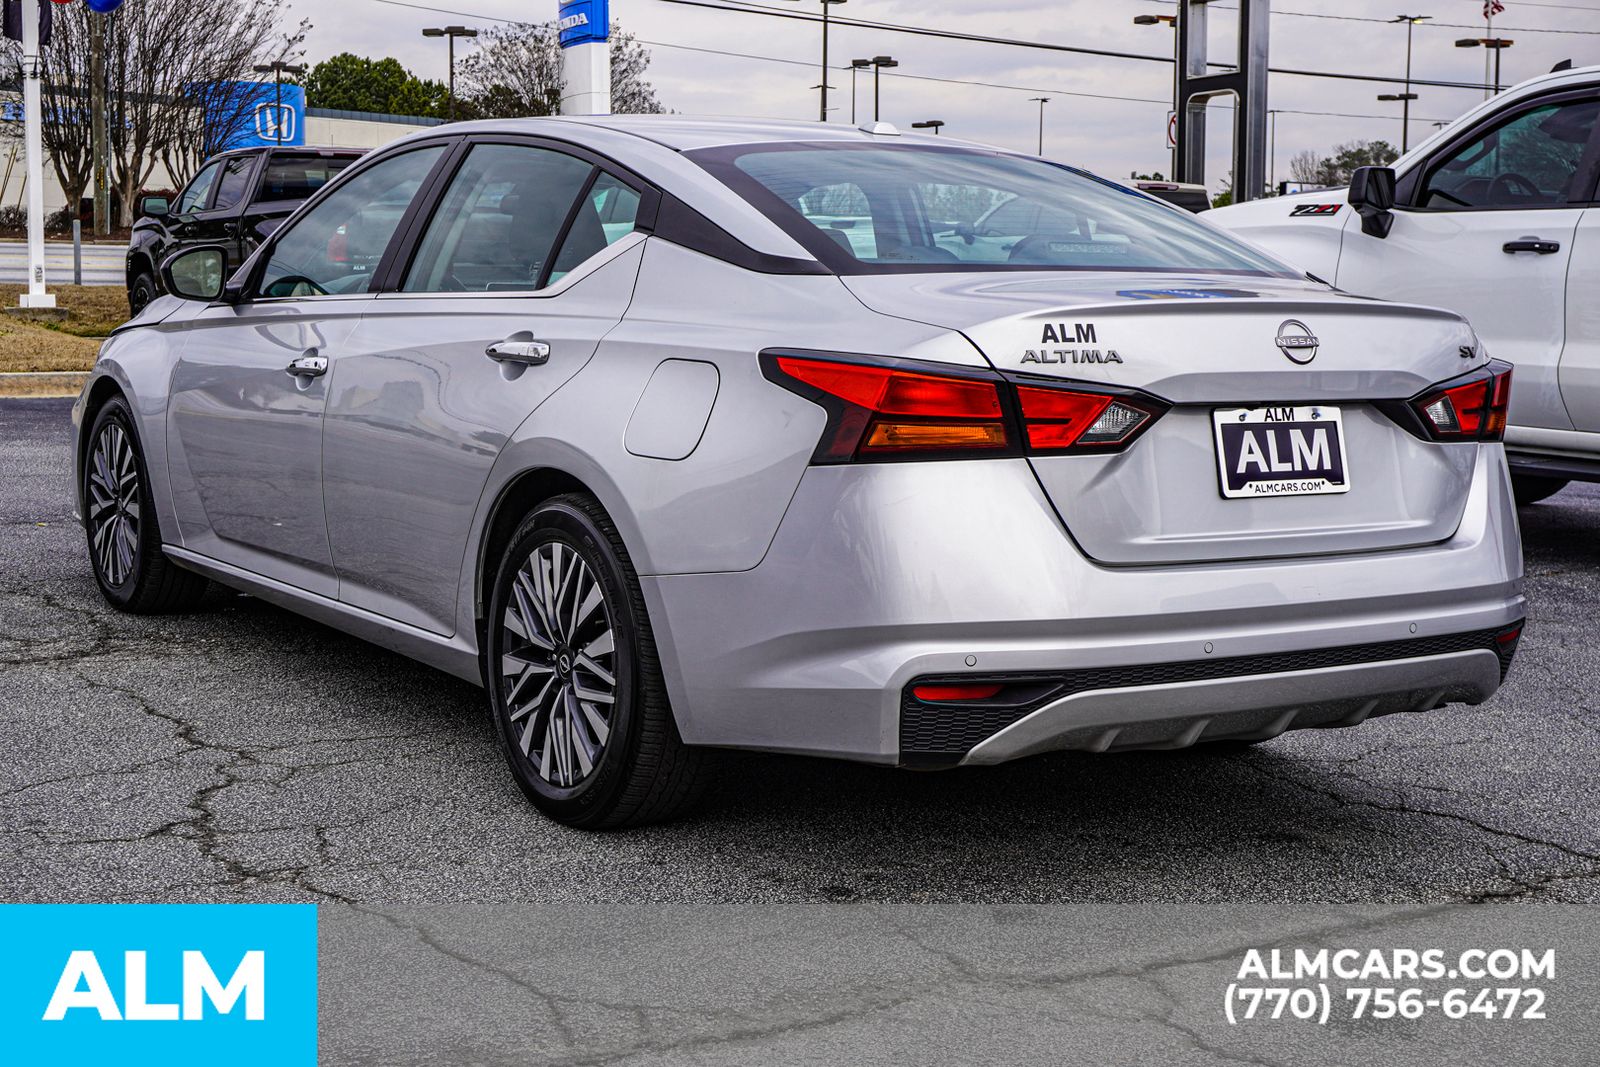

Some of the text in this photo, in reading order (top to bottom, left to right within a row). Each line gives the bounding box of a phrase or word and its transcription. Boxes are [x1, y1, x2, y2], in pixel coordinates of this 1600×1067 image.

[1041, 323, 1097, 344] ALM
[1277, 337, 1319, 346] NISSAN
[1020, 349, 1124, 364] ALTIMA
[1264, 407, 1295, 422] ALM
[1236, 428, 1333, 474] ALM
[1254, 482, 1322, 494] ALMCARS.COM
